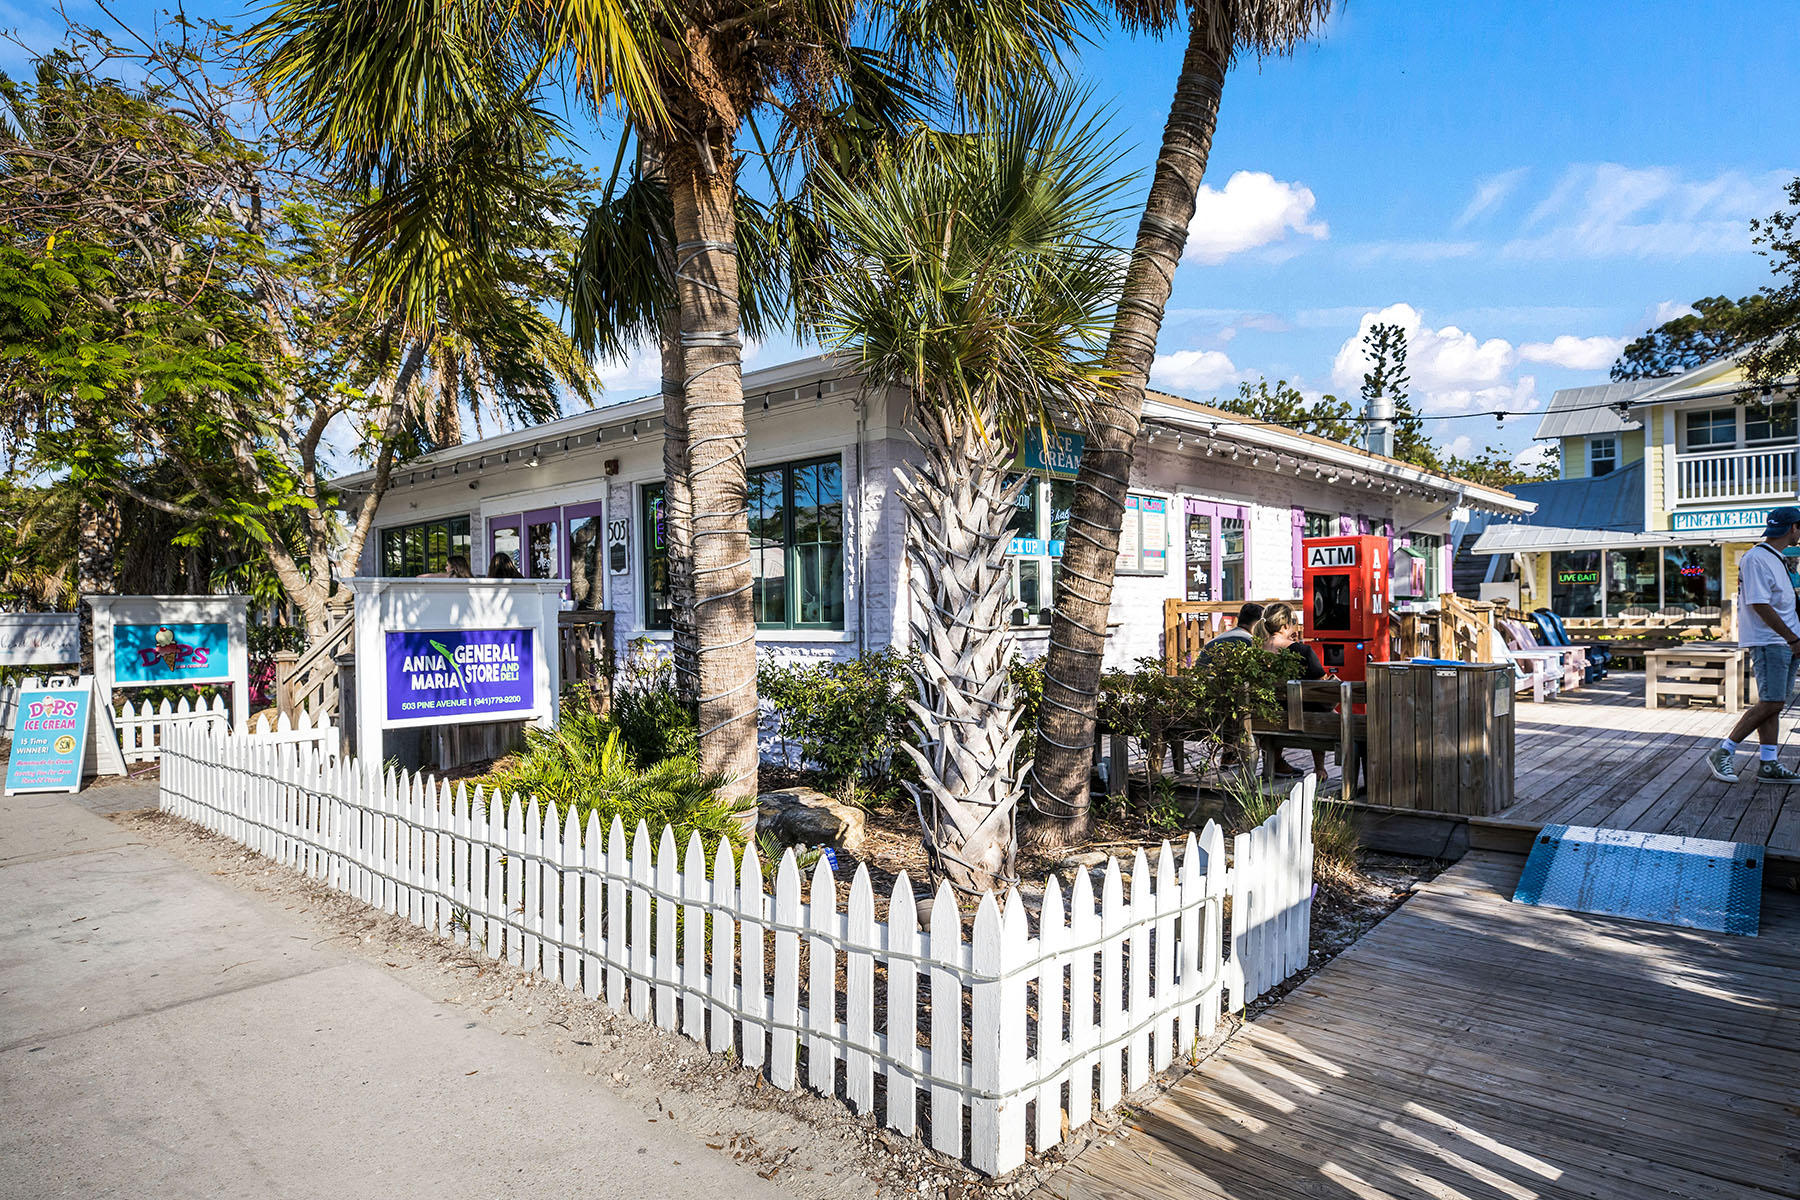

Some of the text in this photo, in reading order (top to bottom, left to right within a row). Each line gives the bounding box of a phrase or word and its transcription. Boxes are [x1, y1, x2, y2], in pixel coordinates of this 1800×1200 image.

[1677, 513, 1708, 528] PINE
[1710, 512, 1737, 526] AVE
[608, 520, 626, 541] 503
[1007, 538, 1038, 553] ICK UP
[1311, 546, 1353, 566] ATM
[1559, 573, 1597, 582] LIVE BAIT
[1680, 567, 1705, 575] OPEN
[1373, 548, 1383, 614] ATM
[454, 643, 519, 664] GENERAL
[402, 655, 447, 673] ANNA
[500, 662, 520, 672] AND
[465, 663, 500, 684] STORE
[500, 671, 520, 681] DELI
[411, 672, 460, 691] MARIA
[402, 702, 416, 711] 503
[417, 700, 435, 710] PINE
[436, 698, 468, 709] AVENUE
[24, 719, 76, 731] ICE CREAM
[16, 746, 49, 755] WINNER!
